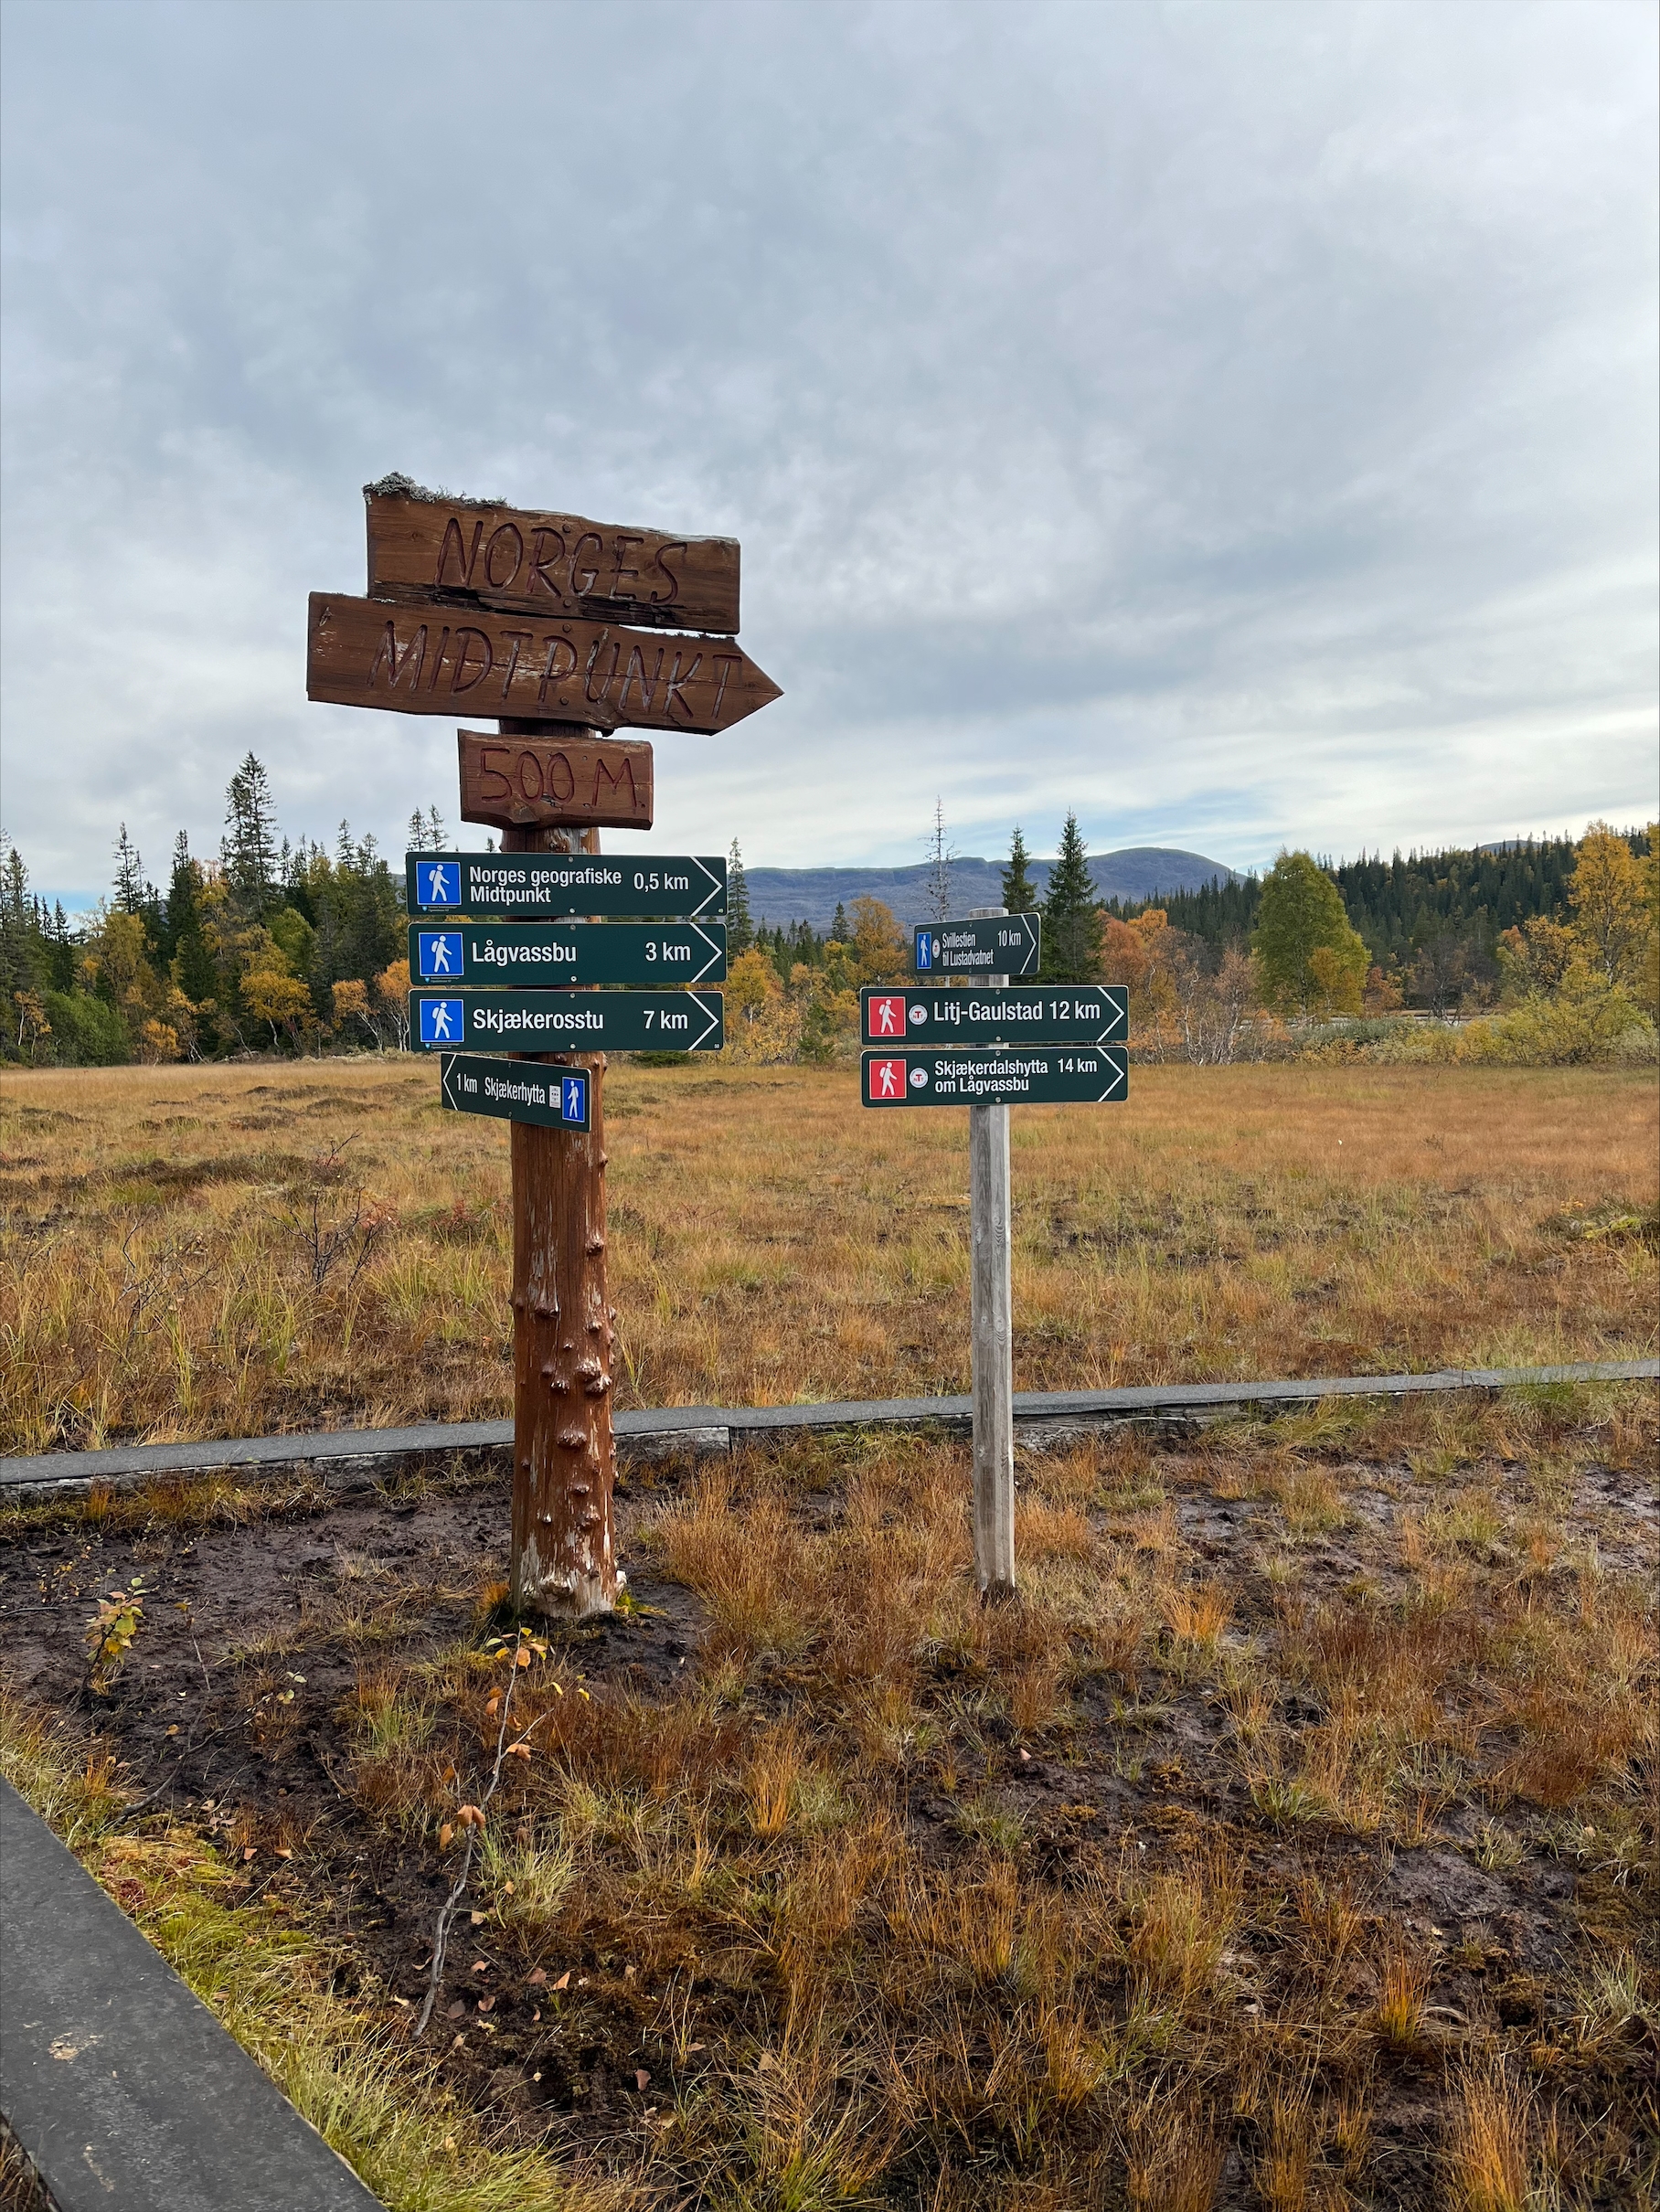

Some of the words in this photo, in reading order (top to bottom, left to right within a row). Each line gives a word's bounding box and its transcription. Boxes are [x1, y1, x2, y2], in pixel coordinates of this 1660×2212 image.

[434, 517, 687, 605] NORGES
[367, 620, 743, 718] MIDTPUNKT
[480, 747, 576, 804] 500
[469, 866, 527, 885] Norges
[530, 867, 622, 887] geografiske
[633, 872, 660, 893] 0,5
[664, 872, 689, 890] km
[470, 885, 551, 906] Midtpunkt
[942, 931, 976, 949] Svillestien
[997, 930, 1007, 947] 10
[1008, 929, 1022, 946] km
[471, 939, 577, 967] Lågvassbu
[644, 941, 657, 962] 3
[662, 941, 691, 962] km
[942, 951, 950, 966] til
[950, 948, 995, 966] Lustadvatnet
[472, 1008, 604, 1034] Skjækerosstu
[643, 1010, 655, 1029] 7
[660, 1009, 688, 1029] km
[933, 1000, 1043, 1026] Litj-Gaulstad
[1048, 1000, 1070, 1020] 12
[1074, 1000, 1101, 1020] km
[934, 1058, 1048, 1078] Skjækerdalshytta
[1057, 1058, 1074, 1073] 14
[1077, 1058, 1098, 1073] km
[456, 1072, 462, 1091] 1
[463, 1073, 478, 1093] km
[484, 1076, 546, 1107] Skjækerhytta
[934, 1080, 956, 1093] om
[959, 1075, 1029, 1096] Lågvassbu
